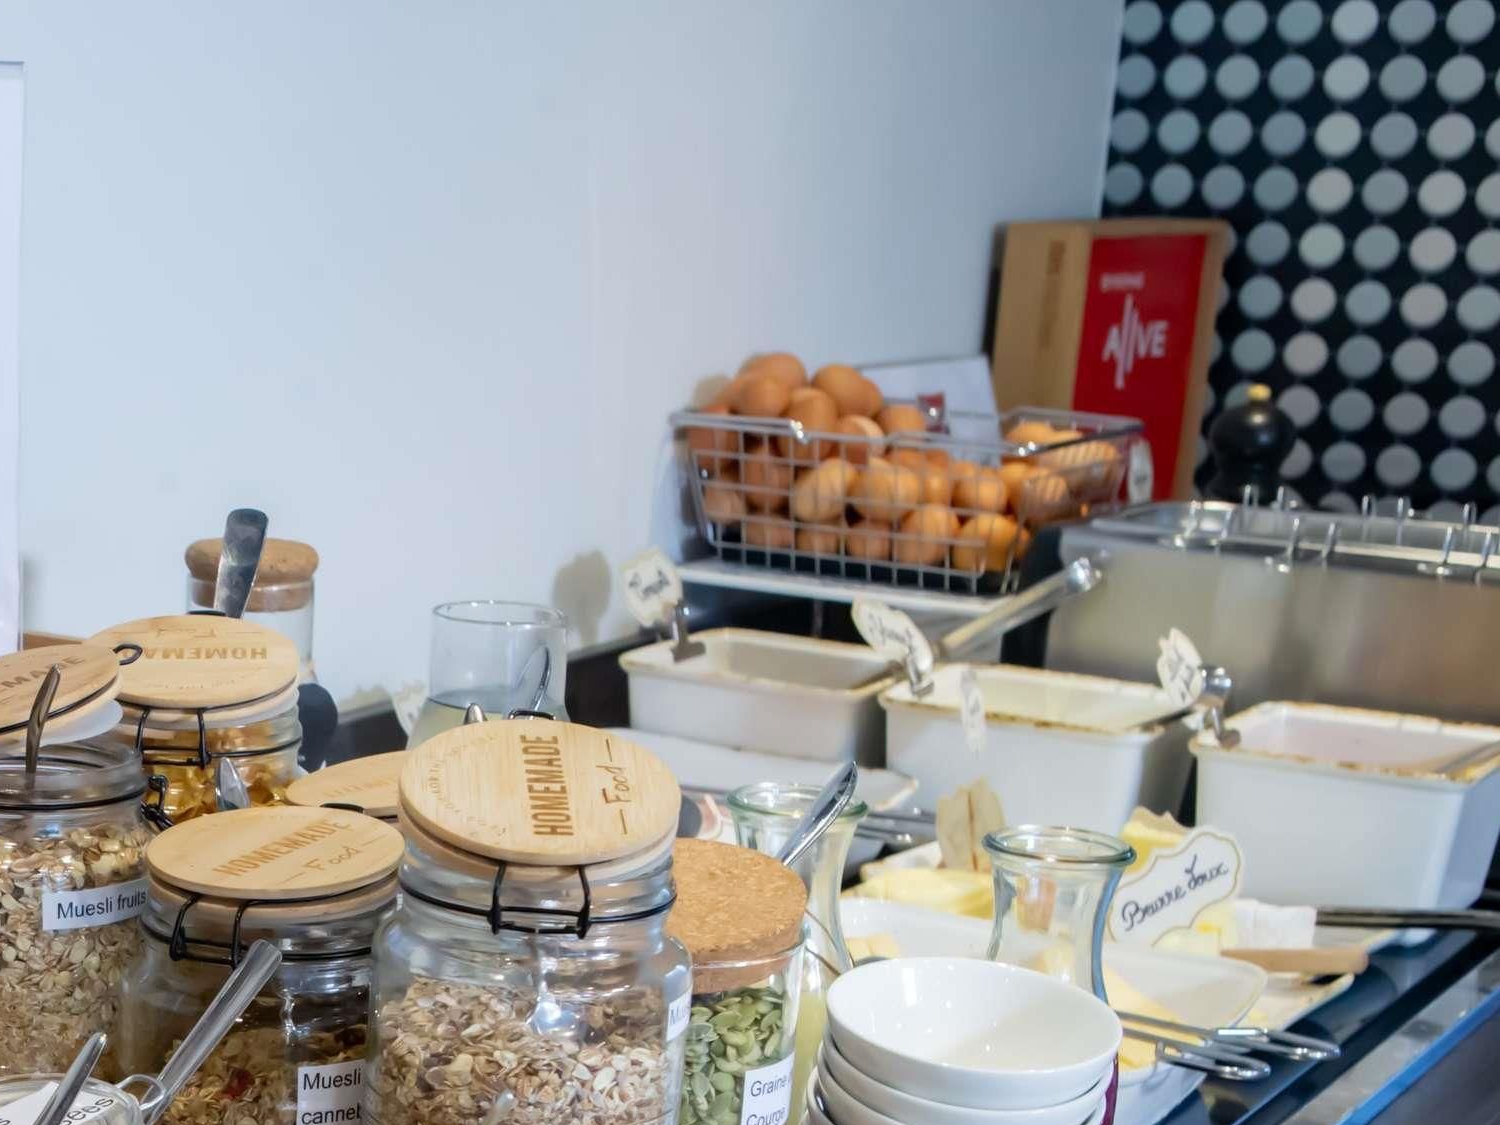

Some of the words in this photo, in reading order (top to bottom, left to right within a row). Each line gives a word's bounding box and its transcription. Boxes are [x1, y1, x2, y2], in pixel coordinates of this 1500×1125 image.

[142, 646, 268, 661] HOMEMA
[520, 733, 575, 836] HOMEMADE
[595, 763, 632, 804] Food
[212, 816, 352, 877] HOMEMADE
[303, 845, 362, 872] Food
[57, 896, 113, 919] Muesli
[117, 889, 147, 911] fruits
[1121, 884, 1187, 932] Beurre
[302, 1067, 362, 1090] Muesli
